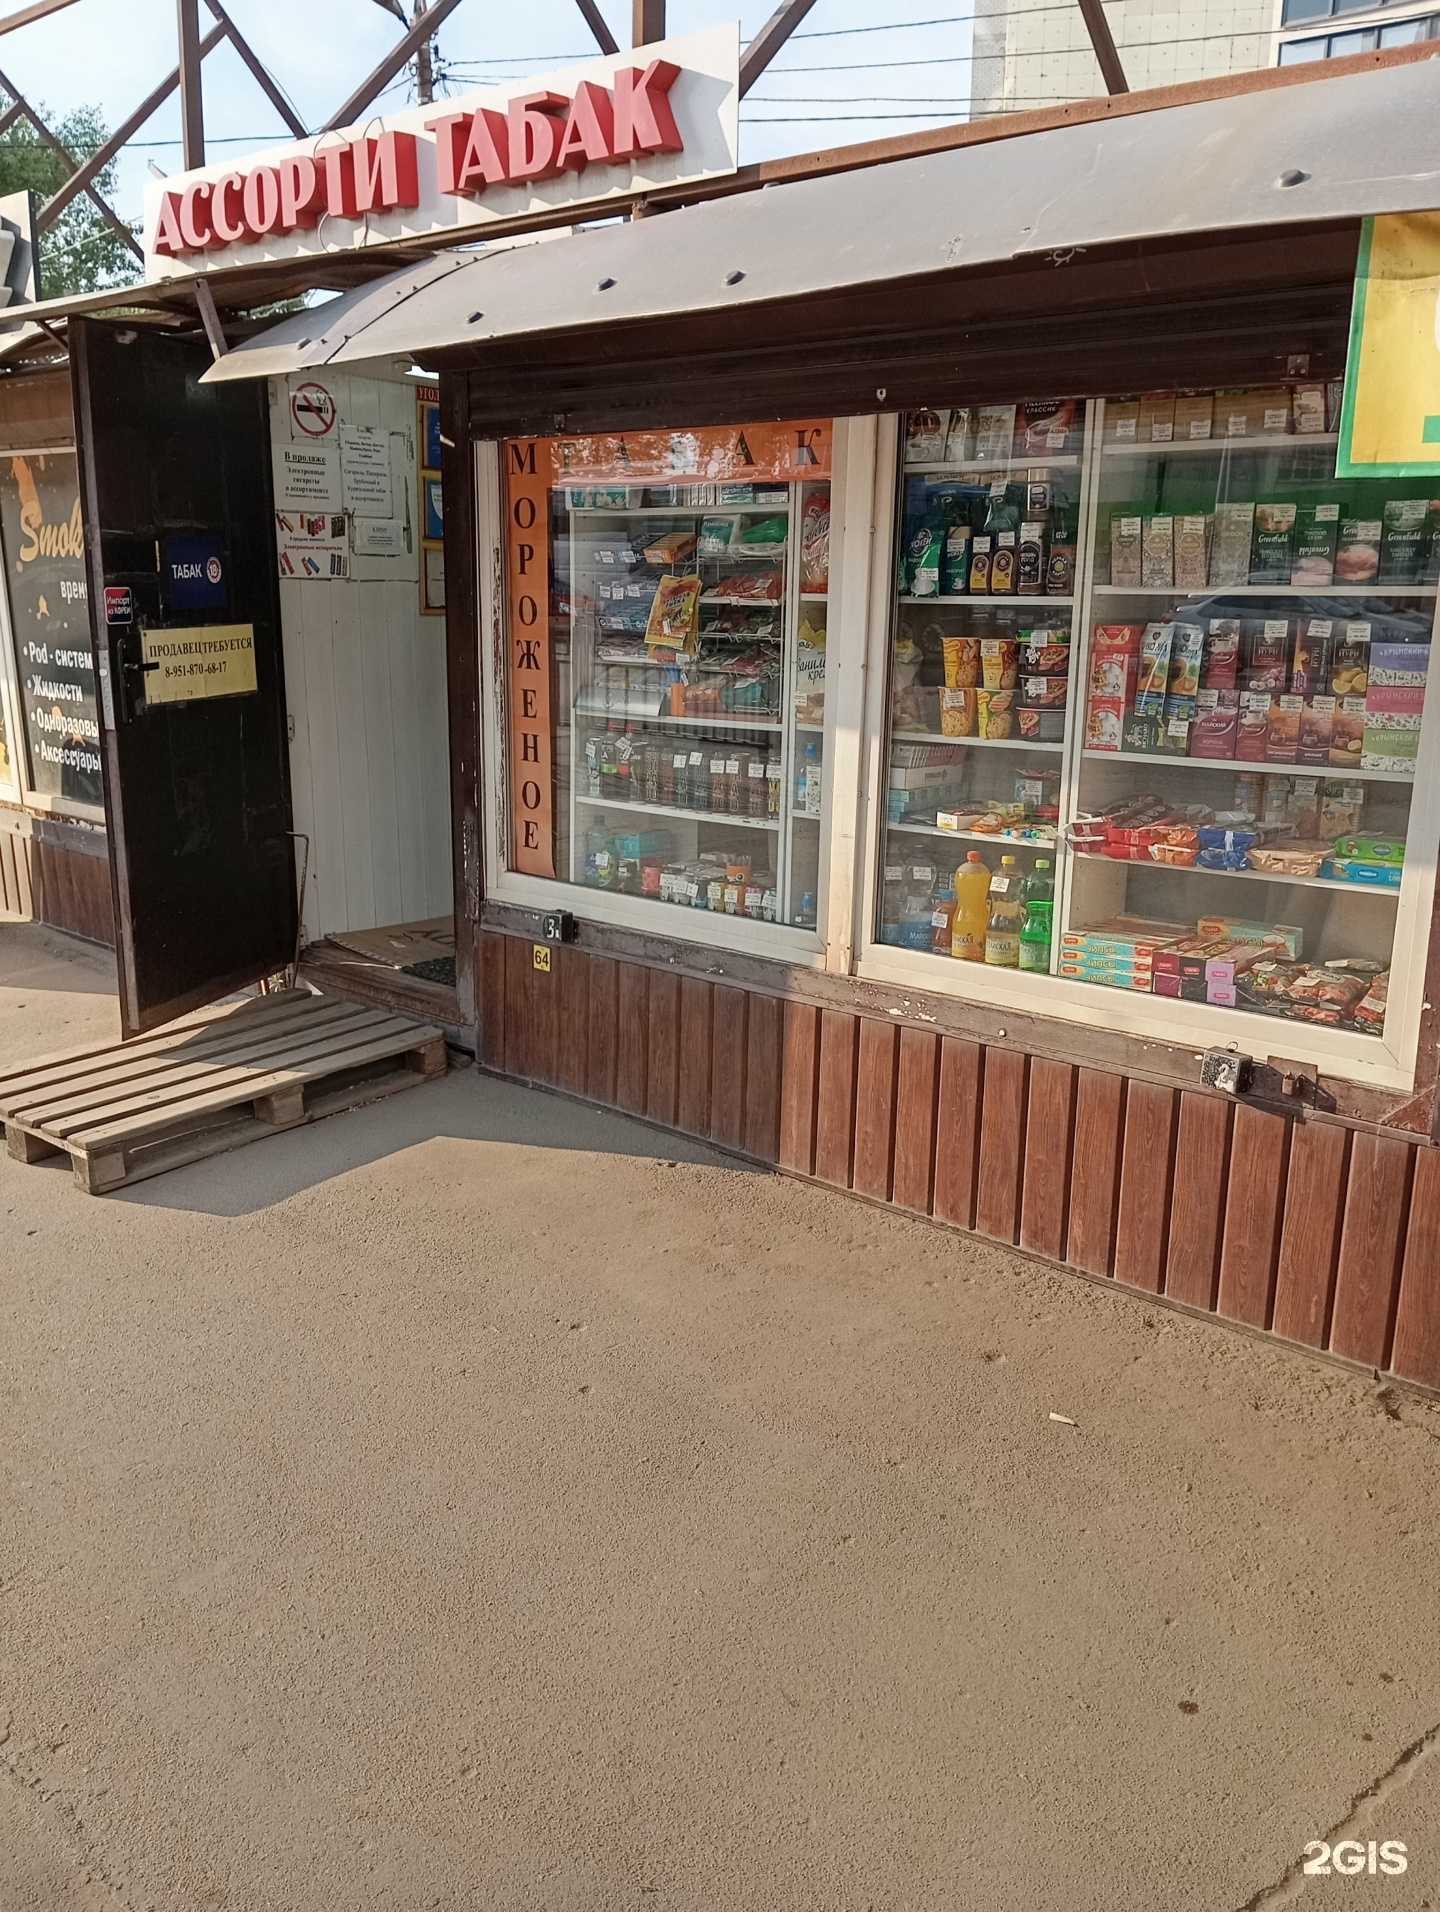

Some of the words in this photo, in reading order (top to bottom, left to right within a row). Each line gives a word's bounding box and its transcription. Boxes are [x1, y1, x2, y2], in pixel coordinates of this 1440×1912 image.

[152, 130, 418, 257] АССОРТИ
[424, 59, 683, 196] ТАБАК
[171, 563, 202, 580] ТАБАК
[29, 641, 49, 665] Pod
[511, 443, 541, 850] МОРОЖЕНОЕ
[165, 660, 227, 678] 8-951-870-68-17
[32, 674, 83, 703] Жидкости
[535, 950, 550, 968] 64
